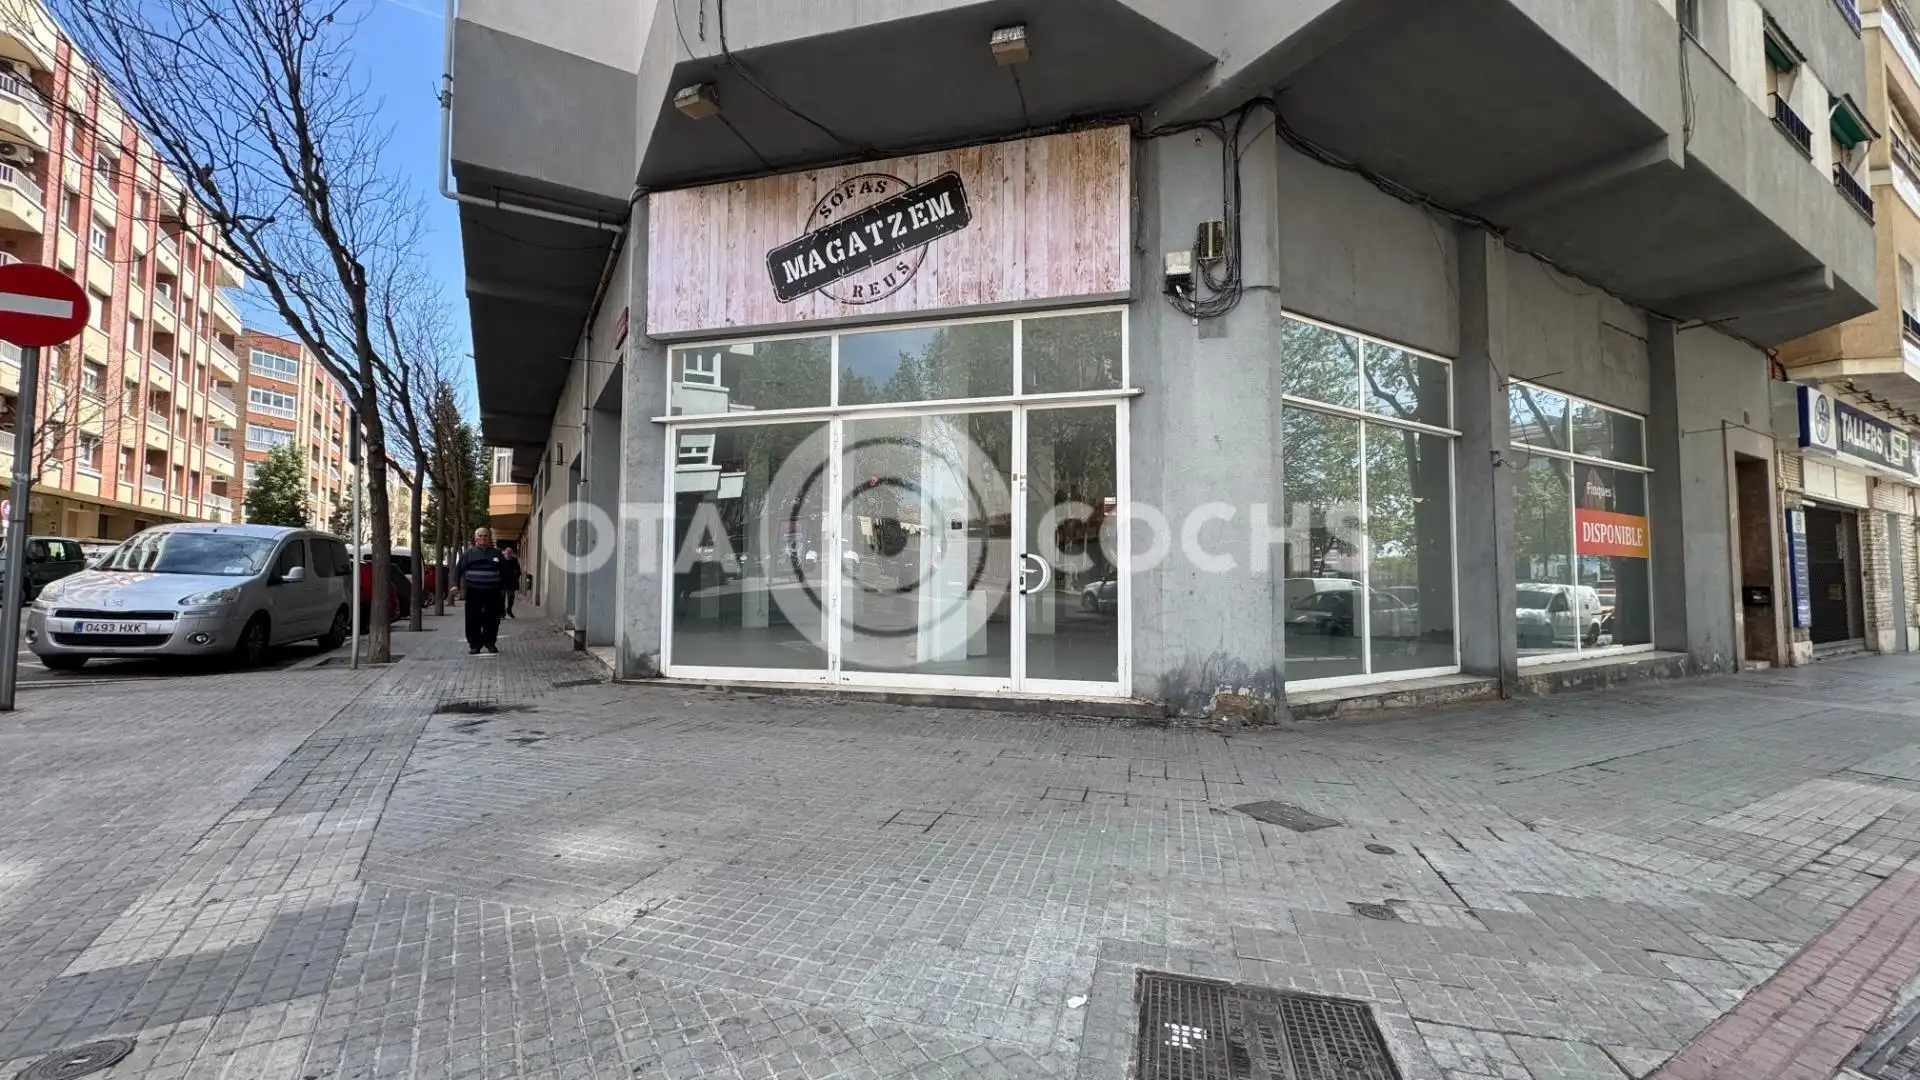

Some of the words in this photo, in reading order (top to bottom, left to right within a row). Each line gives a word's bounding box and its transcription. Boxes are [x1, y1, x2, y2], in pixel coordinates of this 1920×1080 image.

[819, 179, 888, 219] SOFAS
[782, 191, 955, 284] MAGATZEM
[852, 261, 909, 298] REUS
[1841, 411, 1883, 454] TALLERS
[1586, 482, 1612, 499] Finques
[1582, 521, 1643, 547] DISPONIBLE
[86, 623, 115, 632] 0493
[119, 623, 141, 633] HXK
